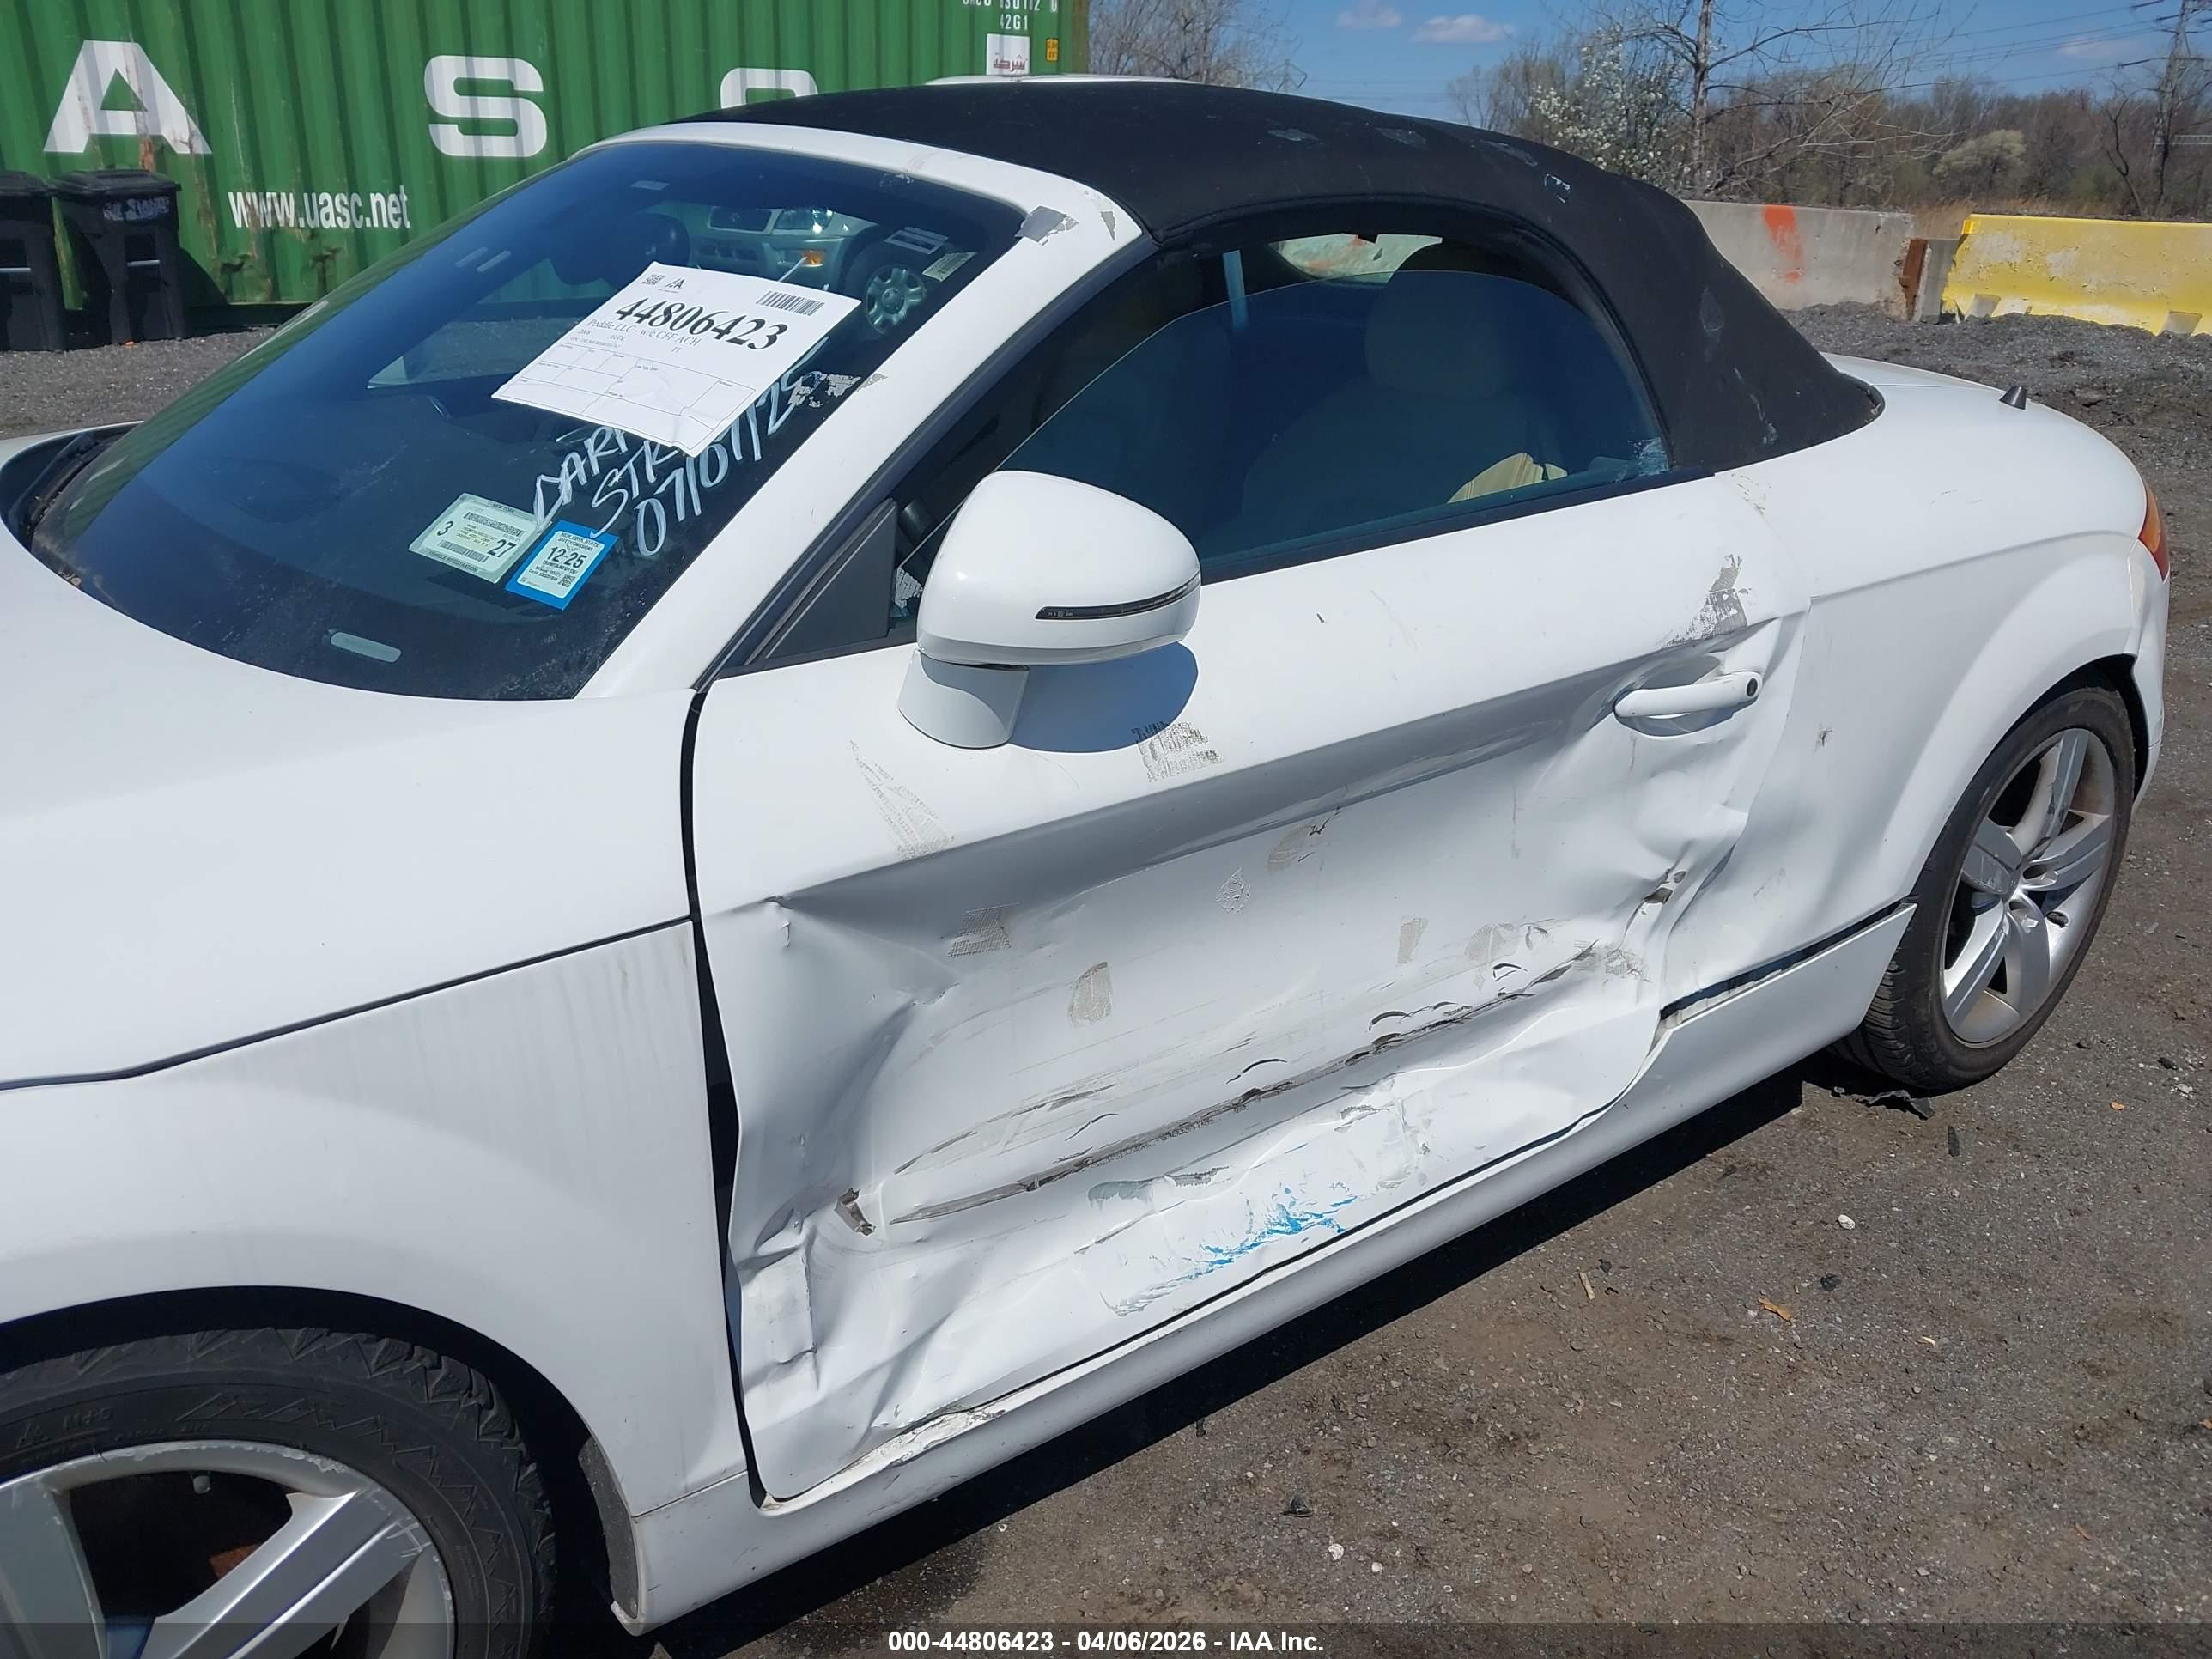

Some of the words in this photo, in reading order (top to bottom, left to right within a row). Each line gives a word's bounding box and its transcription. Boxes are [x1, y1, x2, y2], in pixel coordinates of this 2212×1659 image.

[228, 185, 411, 229] www.uasc.net
[615, 297, 788, 350] 44806423
[437, 520, 454, 537] 3
[487, 538, 517, 558] 27
